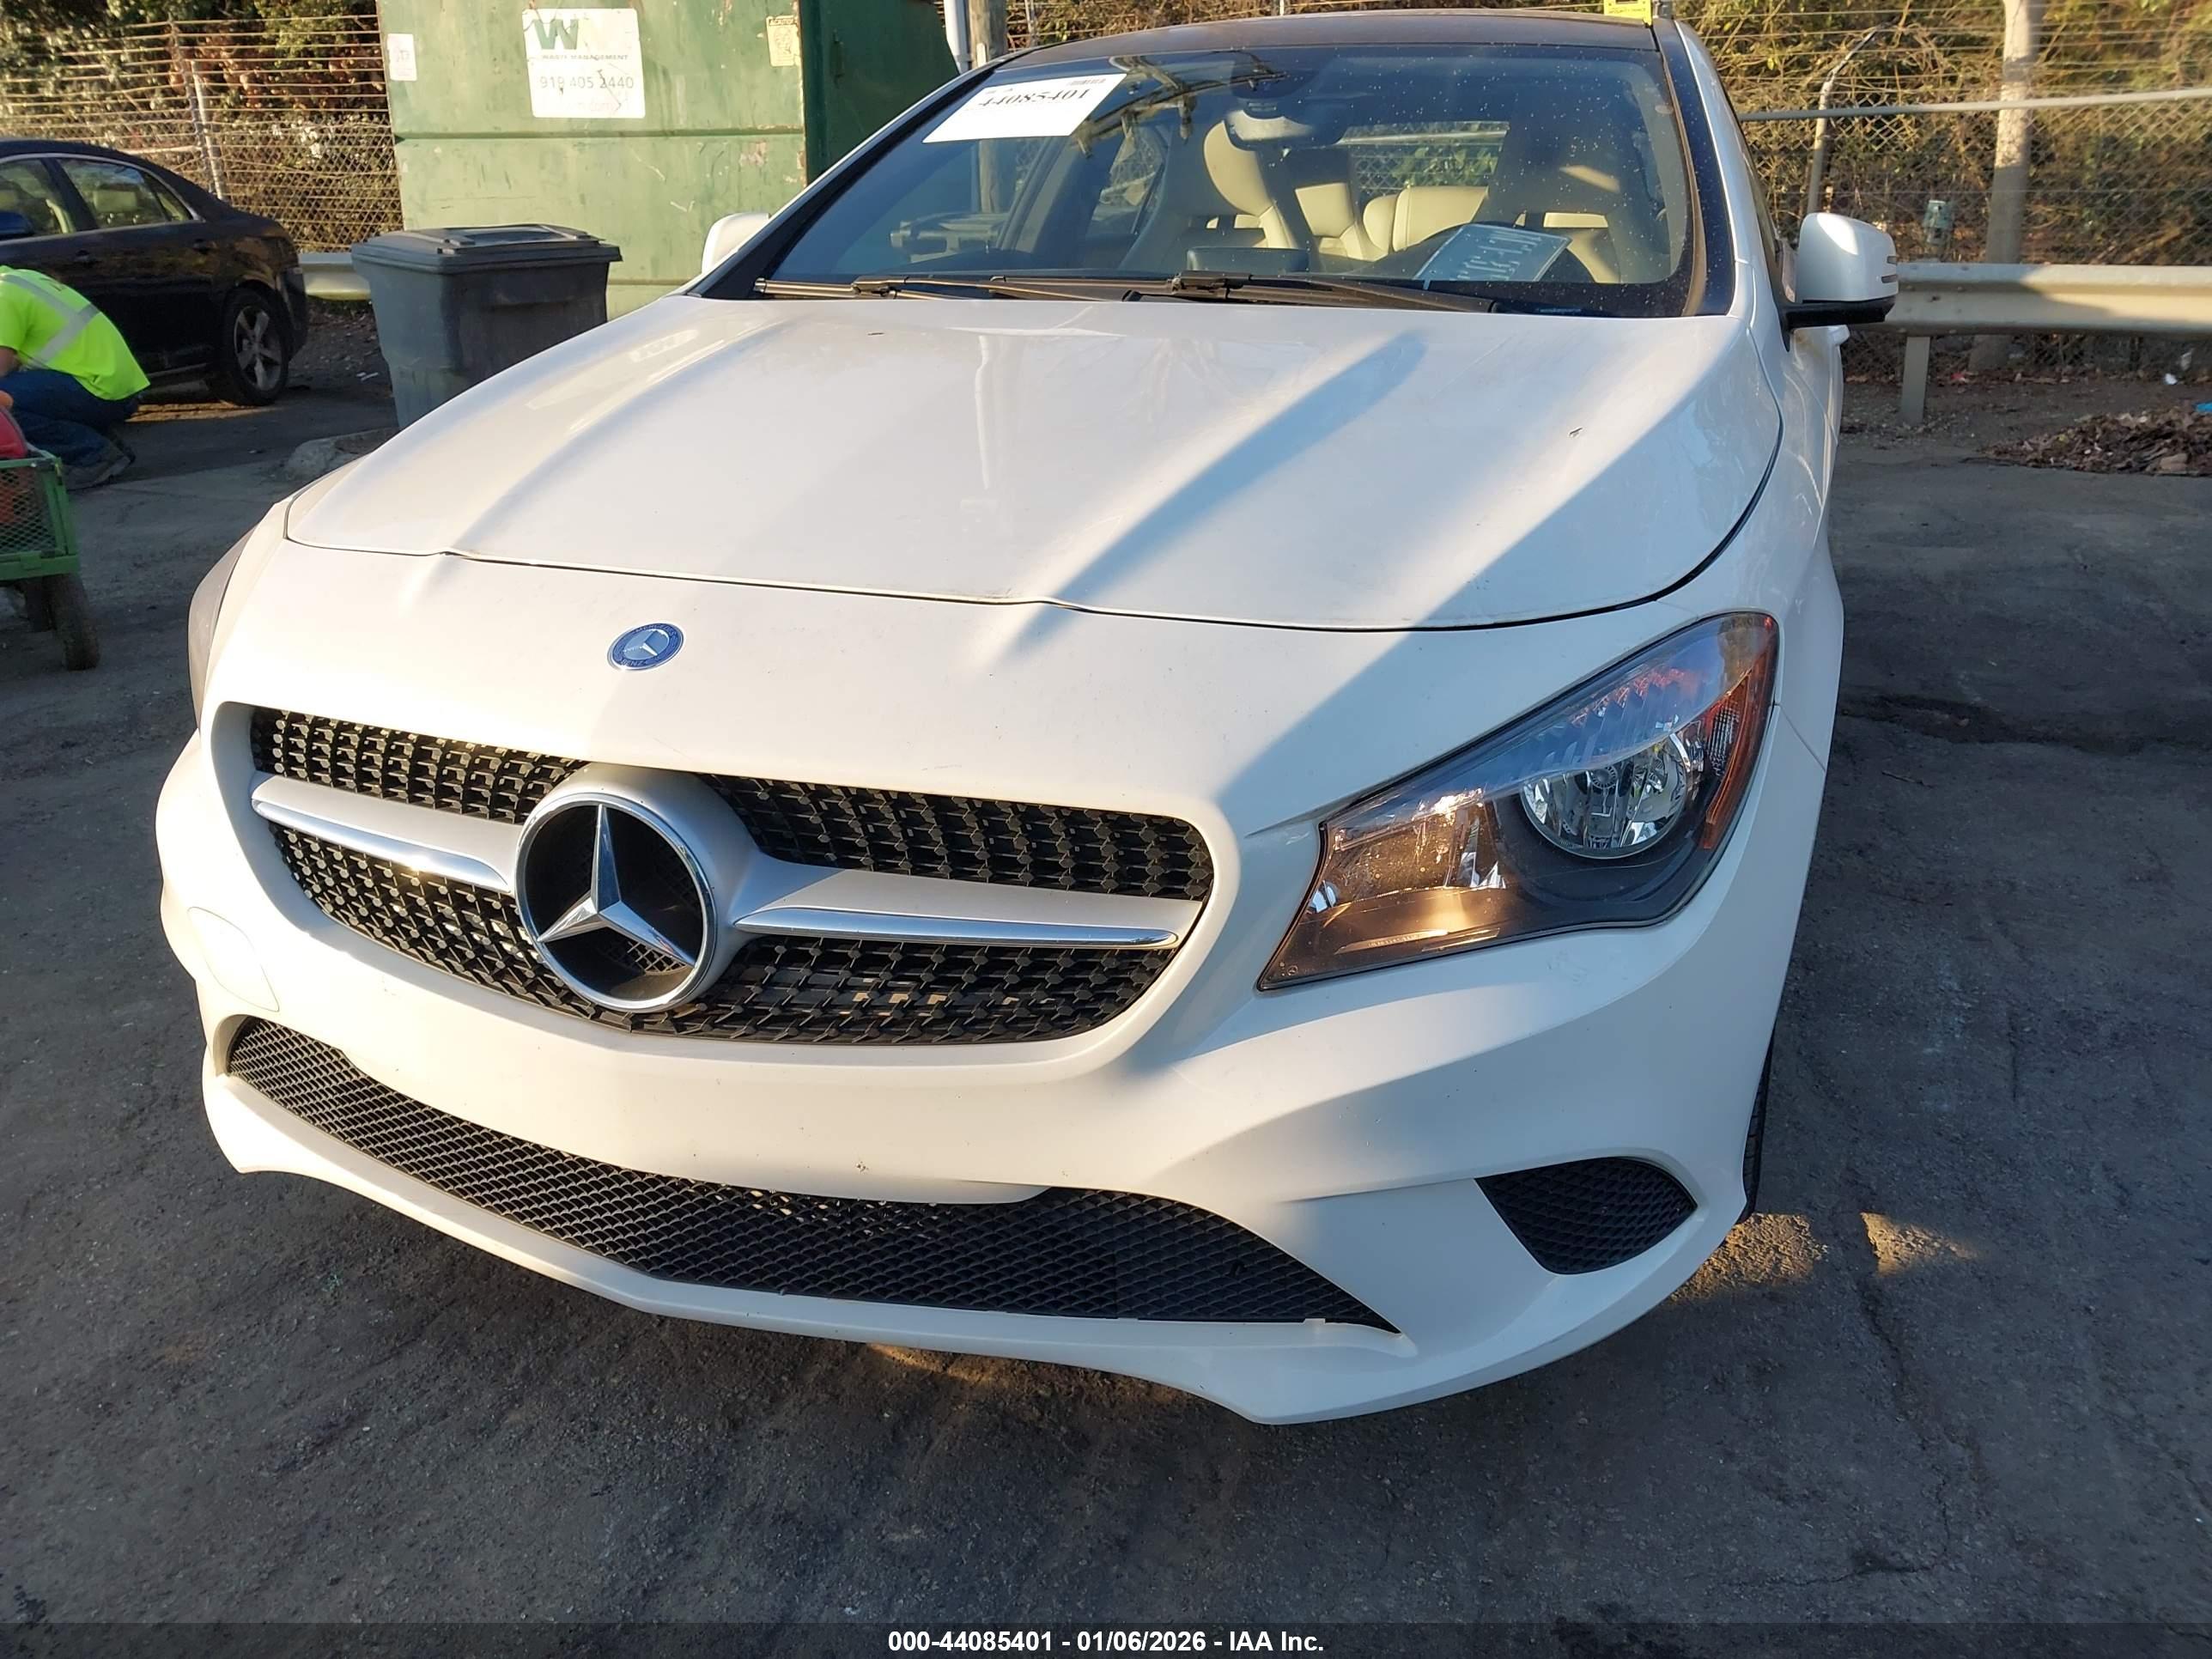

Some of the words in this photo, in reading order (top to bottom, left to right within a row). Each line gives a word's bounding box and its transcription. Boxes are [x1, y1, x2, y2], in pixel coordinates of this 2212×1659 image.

[569, 76, 594, 88] 405
[599, 76, 635, 89] 2440
[978, 88, 1091, 106] 44085401
[621, 658, 644, 666] BENZ
